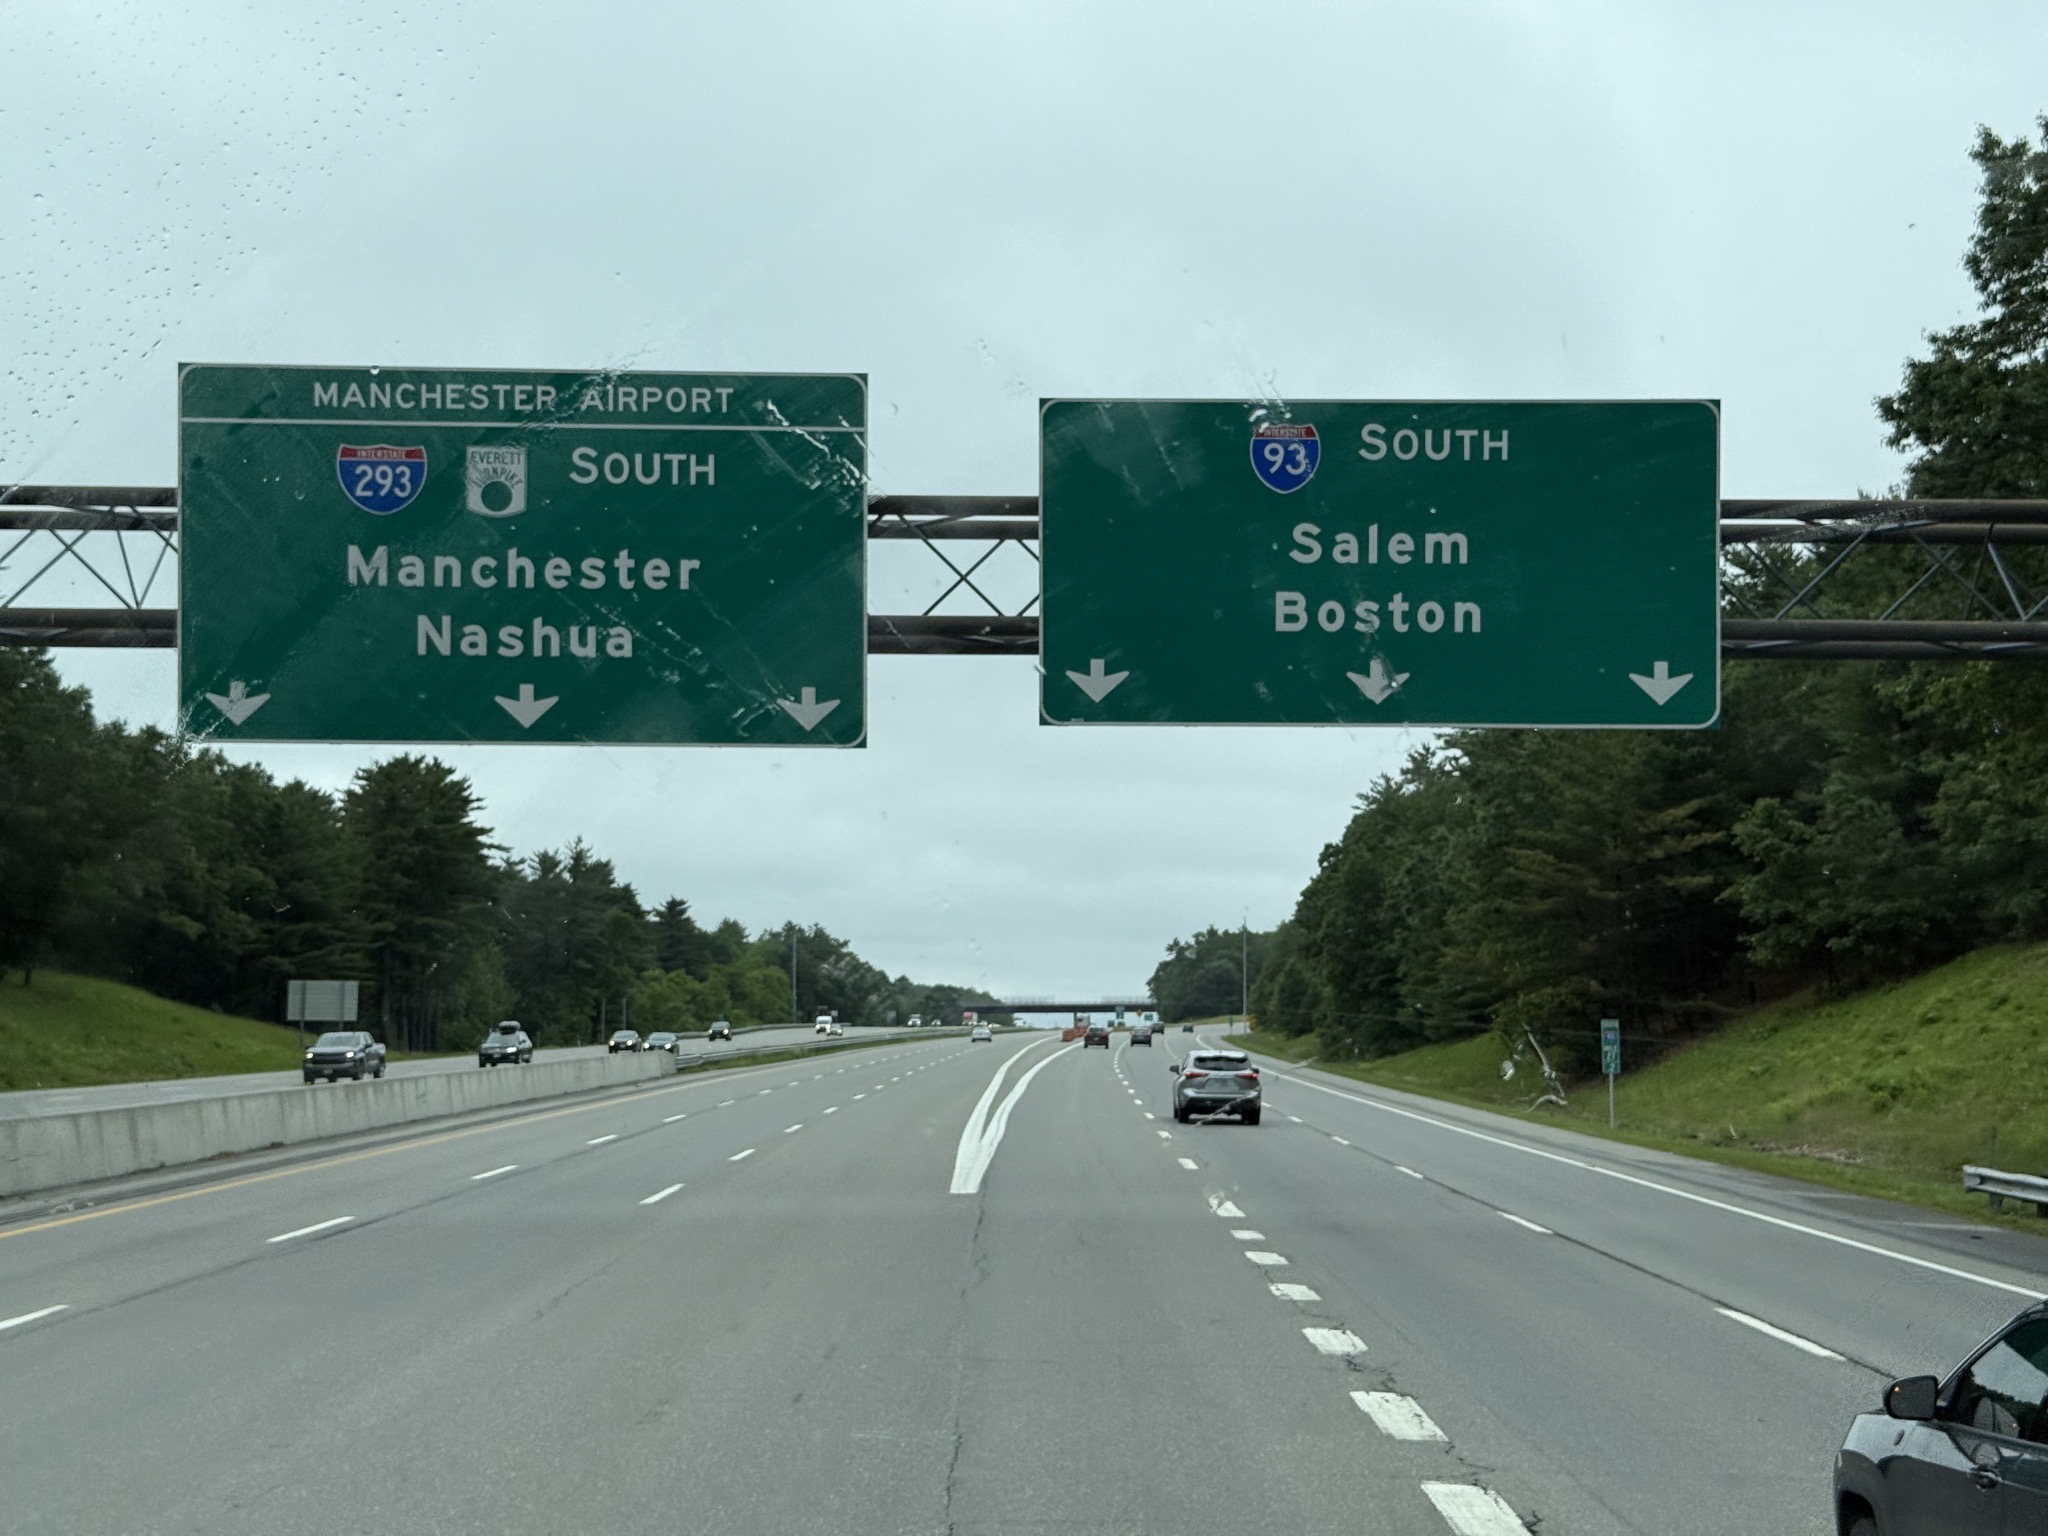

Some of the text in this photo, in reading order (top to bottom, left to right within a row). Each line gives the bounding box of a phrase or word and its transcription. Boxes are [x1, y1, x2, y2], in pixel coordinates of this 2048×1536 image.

[313, 381, 734, 413] MANCHESTER AIRPORT
[356, 449, 407, 459] INTERSTATE
[470, 451, 521, 465] EVERETT
[1263, 442, 1306, 476] 93
[1358, 423, 1509, 461] SOUTH
[355, 464, 412, 498] 293
[569, 446, 715, 486] SOUTH
[1289, 522, 1468, 564] Salem
[347, 544, 701, 590] Manchester
[1275, 591, 1481, 633] Boston
[417, 614, 633, 658] Nashua
